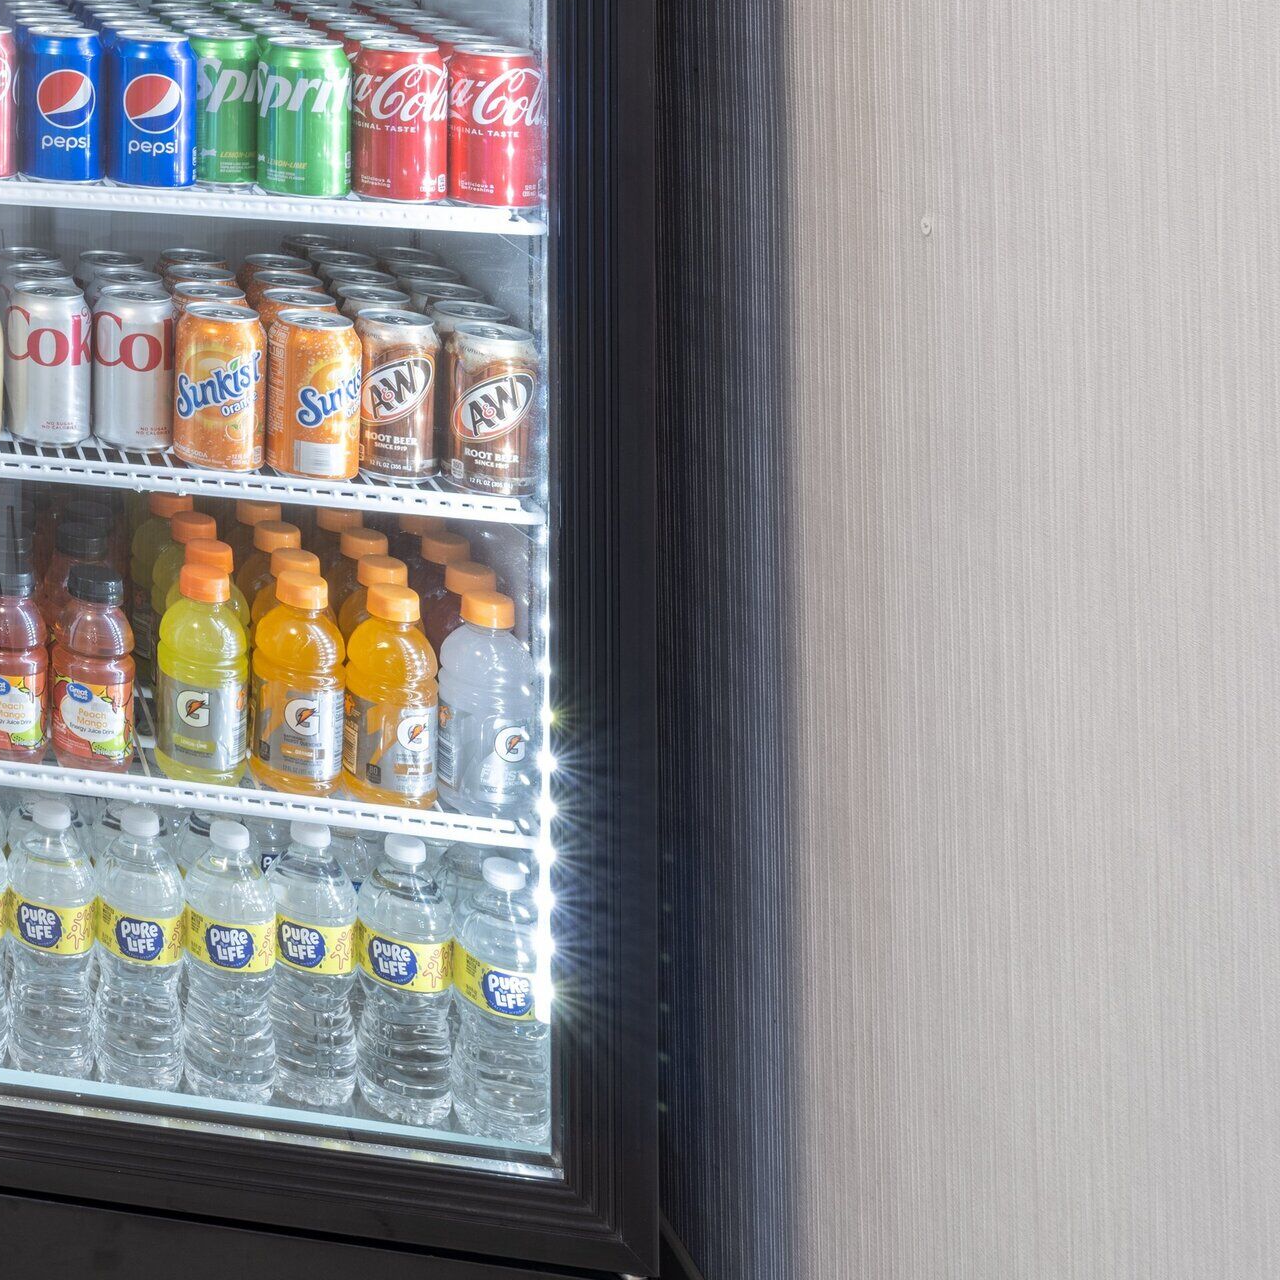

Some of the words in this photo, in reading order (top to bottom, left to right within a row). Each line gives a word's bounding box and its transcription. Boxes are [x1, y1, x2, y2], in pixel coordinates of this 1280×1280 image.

[384, 124, 417, 134] TASTE
[487, 130, 520, 138] TASTE
[41, 135, 90, 151] pepsi
[127, 139, 178, 156] pepsi
[267, 157, 307, 170] LEMON-LIME
[6, 305, 91, 366] Cok
[177, 350, 262, 418] Sunkist
[371, 361, 419, 421] A&W
[221, 392, 258, 418] Orange
[471, 376, 522, 437] A&W
[365, 431, 391, 443] ROOT
[393, 435, 418, 446] BEER
[464, 448, 492, 461] ROOT
[494, 452, 519, 463] BEER
[78, 707, 107, 720] Peach
[176, 690, 210, 728] G
[284, 698, 320, 736] G
[76, 715, 108, 729] Mango
[397, 715, 429, 753] G
[494, 725, 526, 762] G
